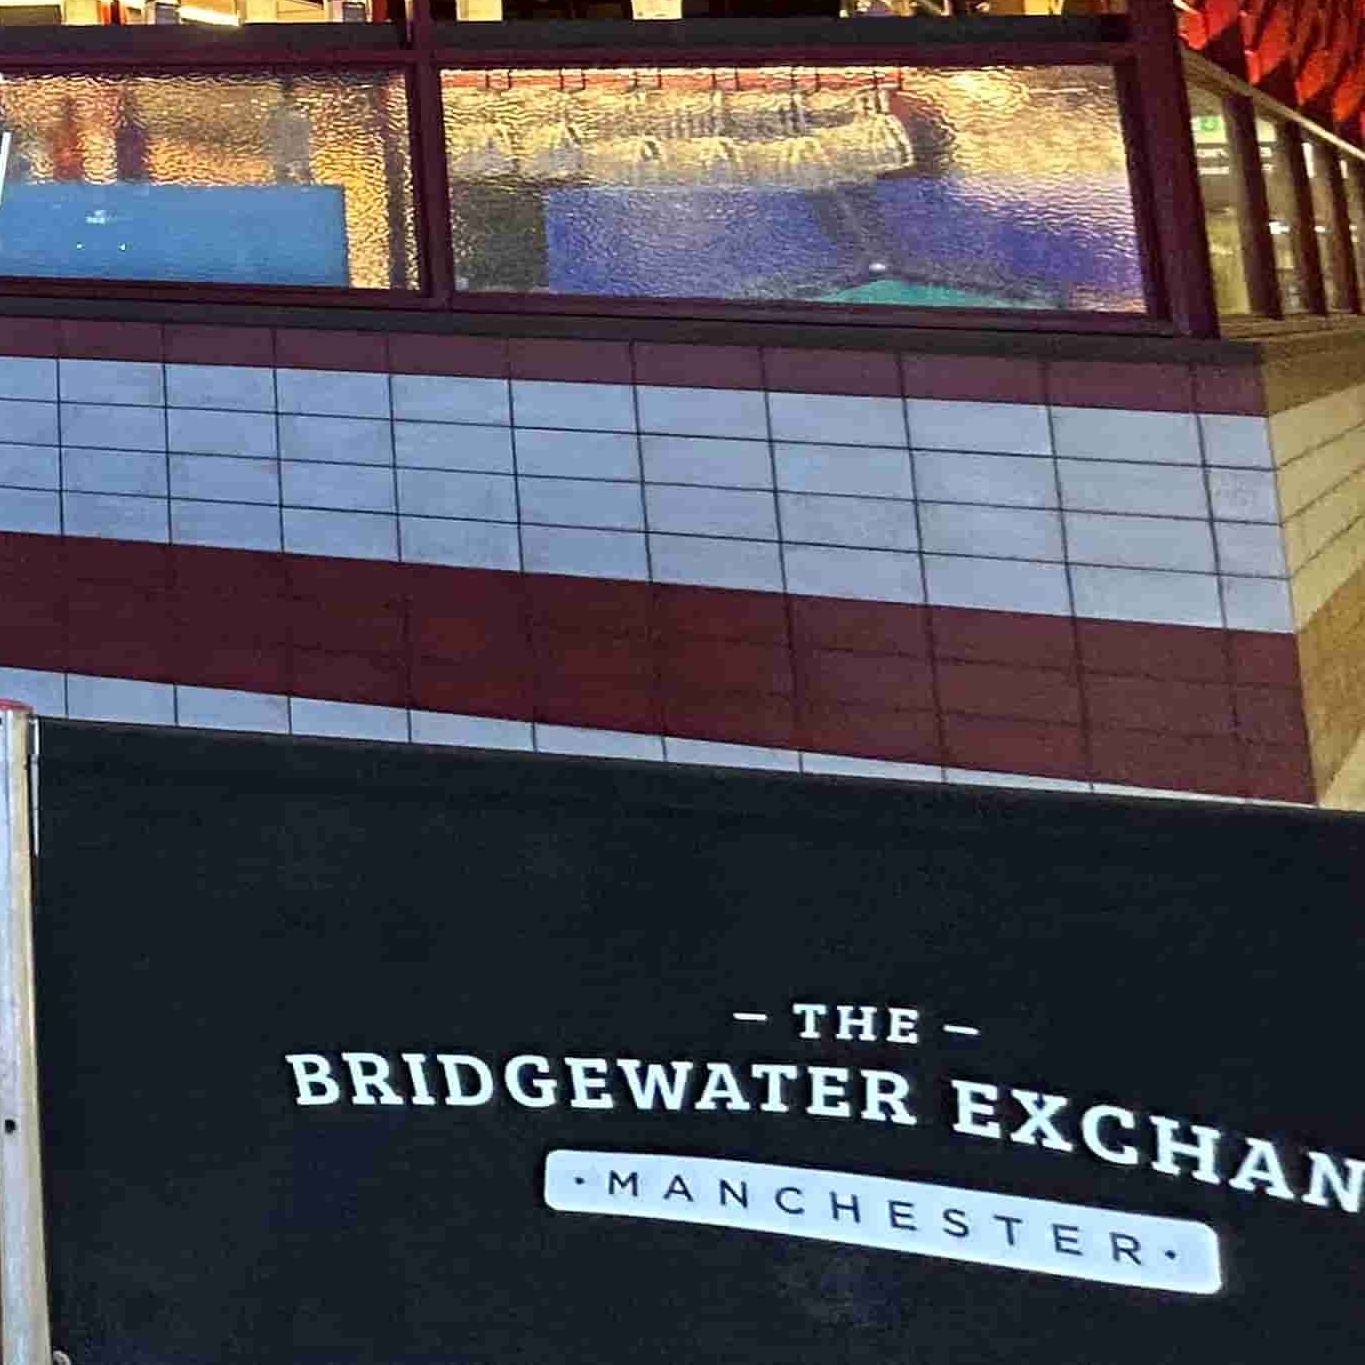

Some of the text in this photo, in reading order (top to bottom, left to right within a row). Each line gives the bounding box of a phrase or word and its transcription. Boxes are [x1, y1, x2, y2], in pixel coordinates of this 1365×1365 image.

[792, 1002, 920, 1045] THE
[284, 1051, 1365, 1214] BRIDGEWATER EXCHAN
[607, 1169, 1144, 1266] MANCHESTER
